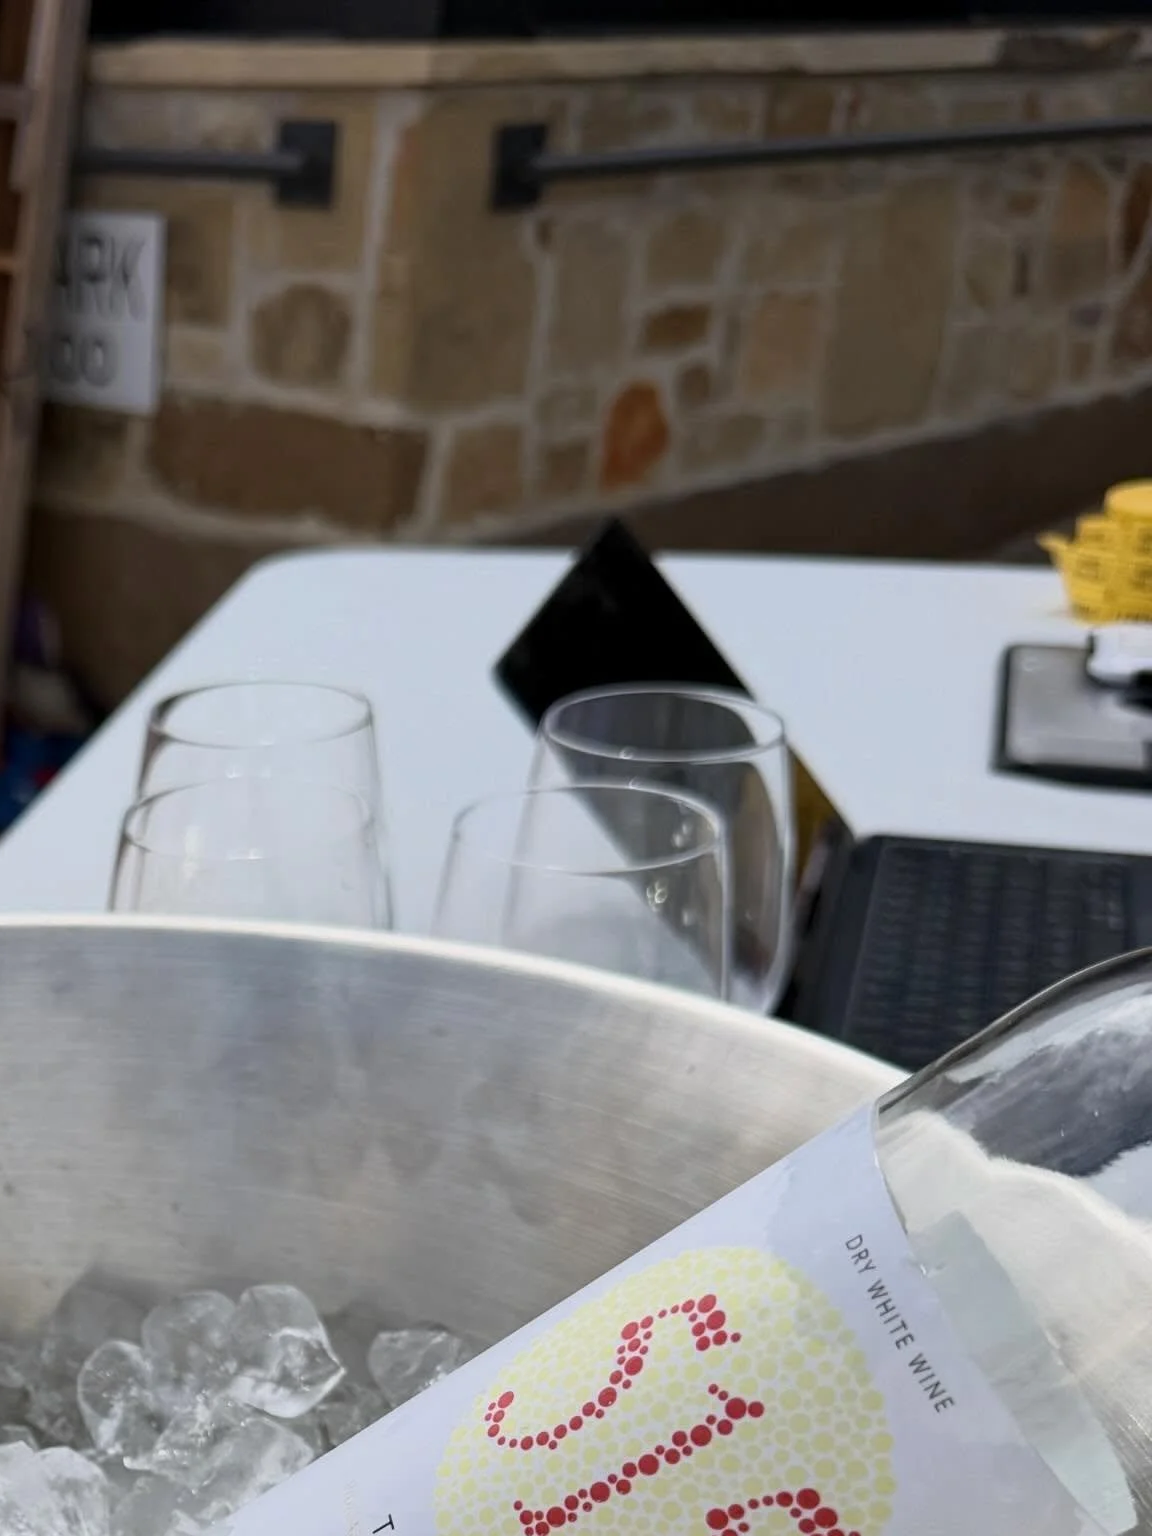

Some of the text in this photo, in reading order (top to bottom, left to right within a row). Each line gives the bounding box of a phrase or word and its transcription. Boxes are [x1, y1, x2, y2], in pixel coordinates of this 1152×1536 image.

[845, 1234, 956, 1414] DRY WHITE WINE
